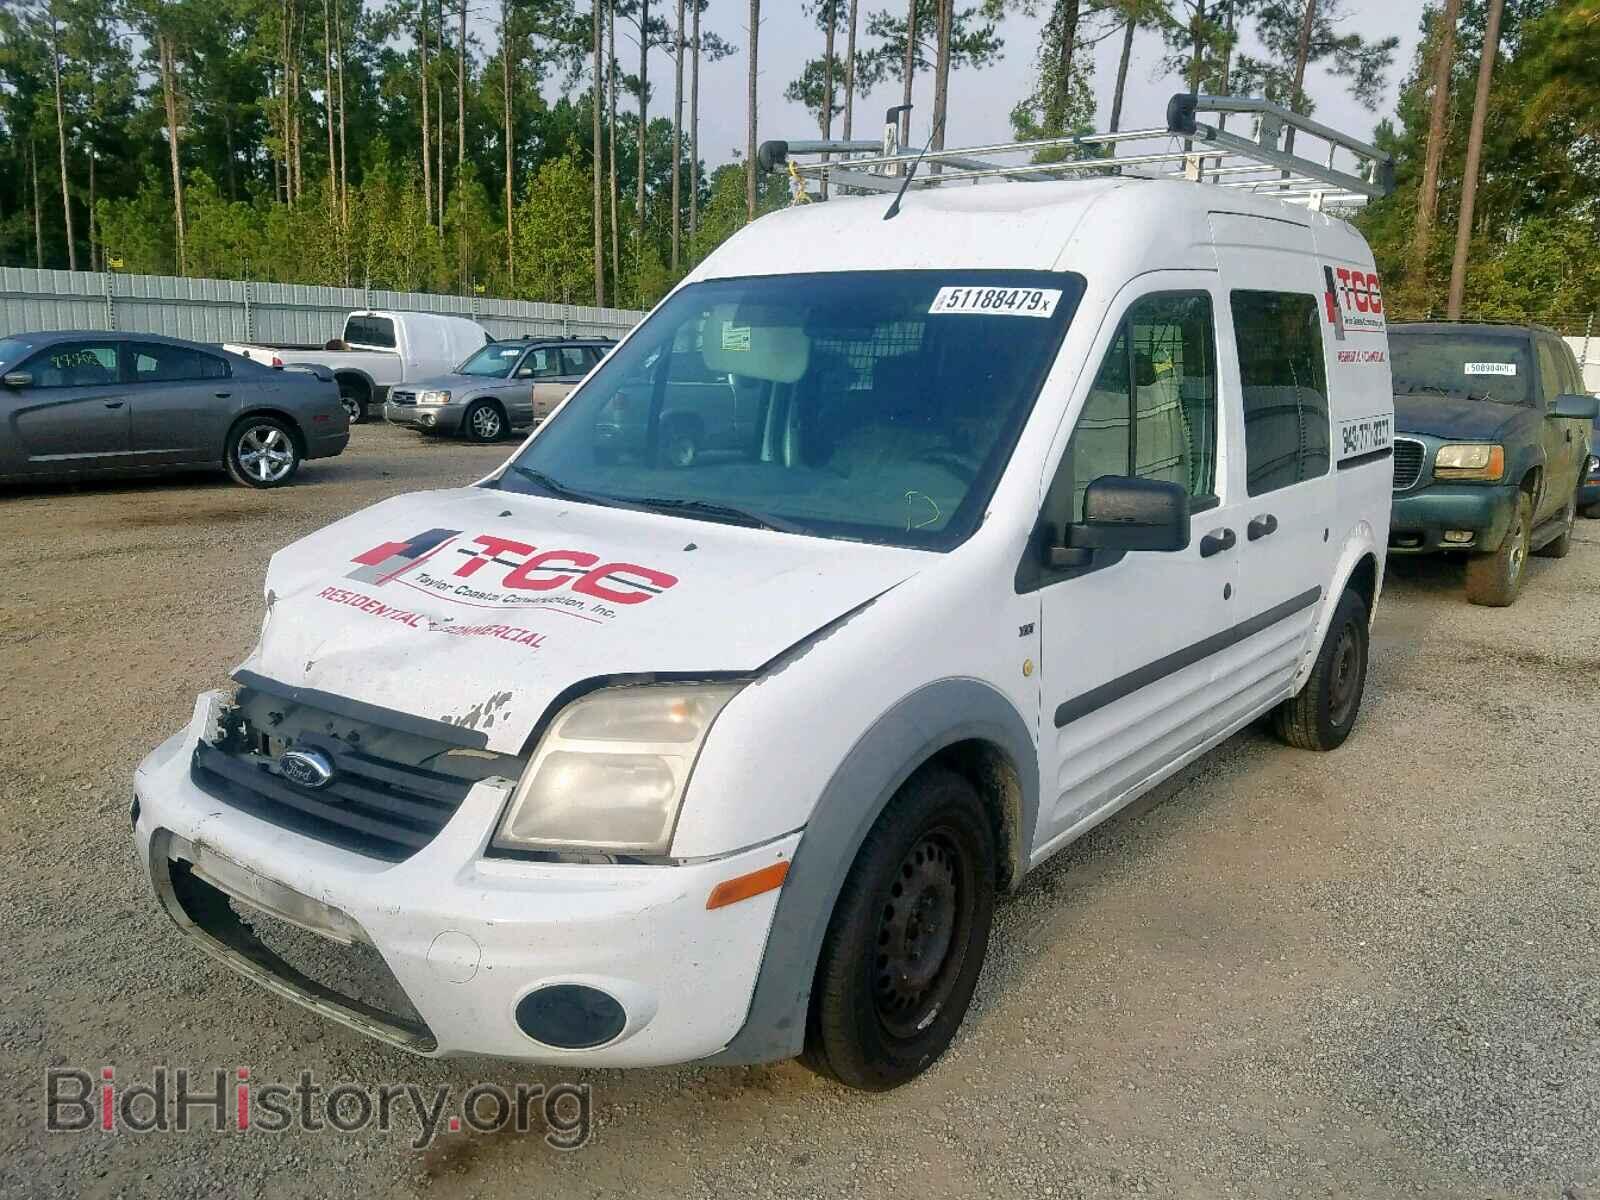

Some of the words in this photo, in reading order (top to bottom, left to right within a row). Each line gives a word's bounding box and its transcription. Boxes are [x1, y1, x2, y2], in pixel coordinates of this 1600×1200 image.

[946, 289, 1043, 311] 51188479
[1336, 267, 1382, 314] TCC
[415, 573, 453, 592] Taylor
[453, 534, 679, 605] TCC
[315, 586, 425, 629] RESIDENTIAL
[286, 758, 313, 781] Ford
